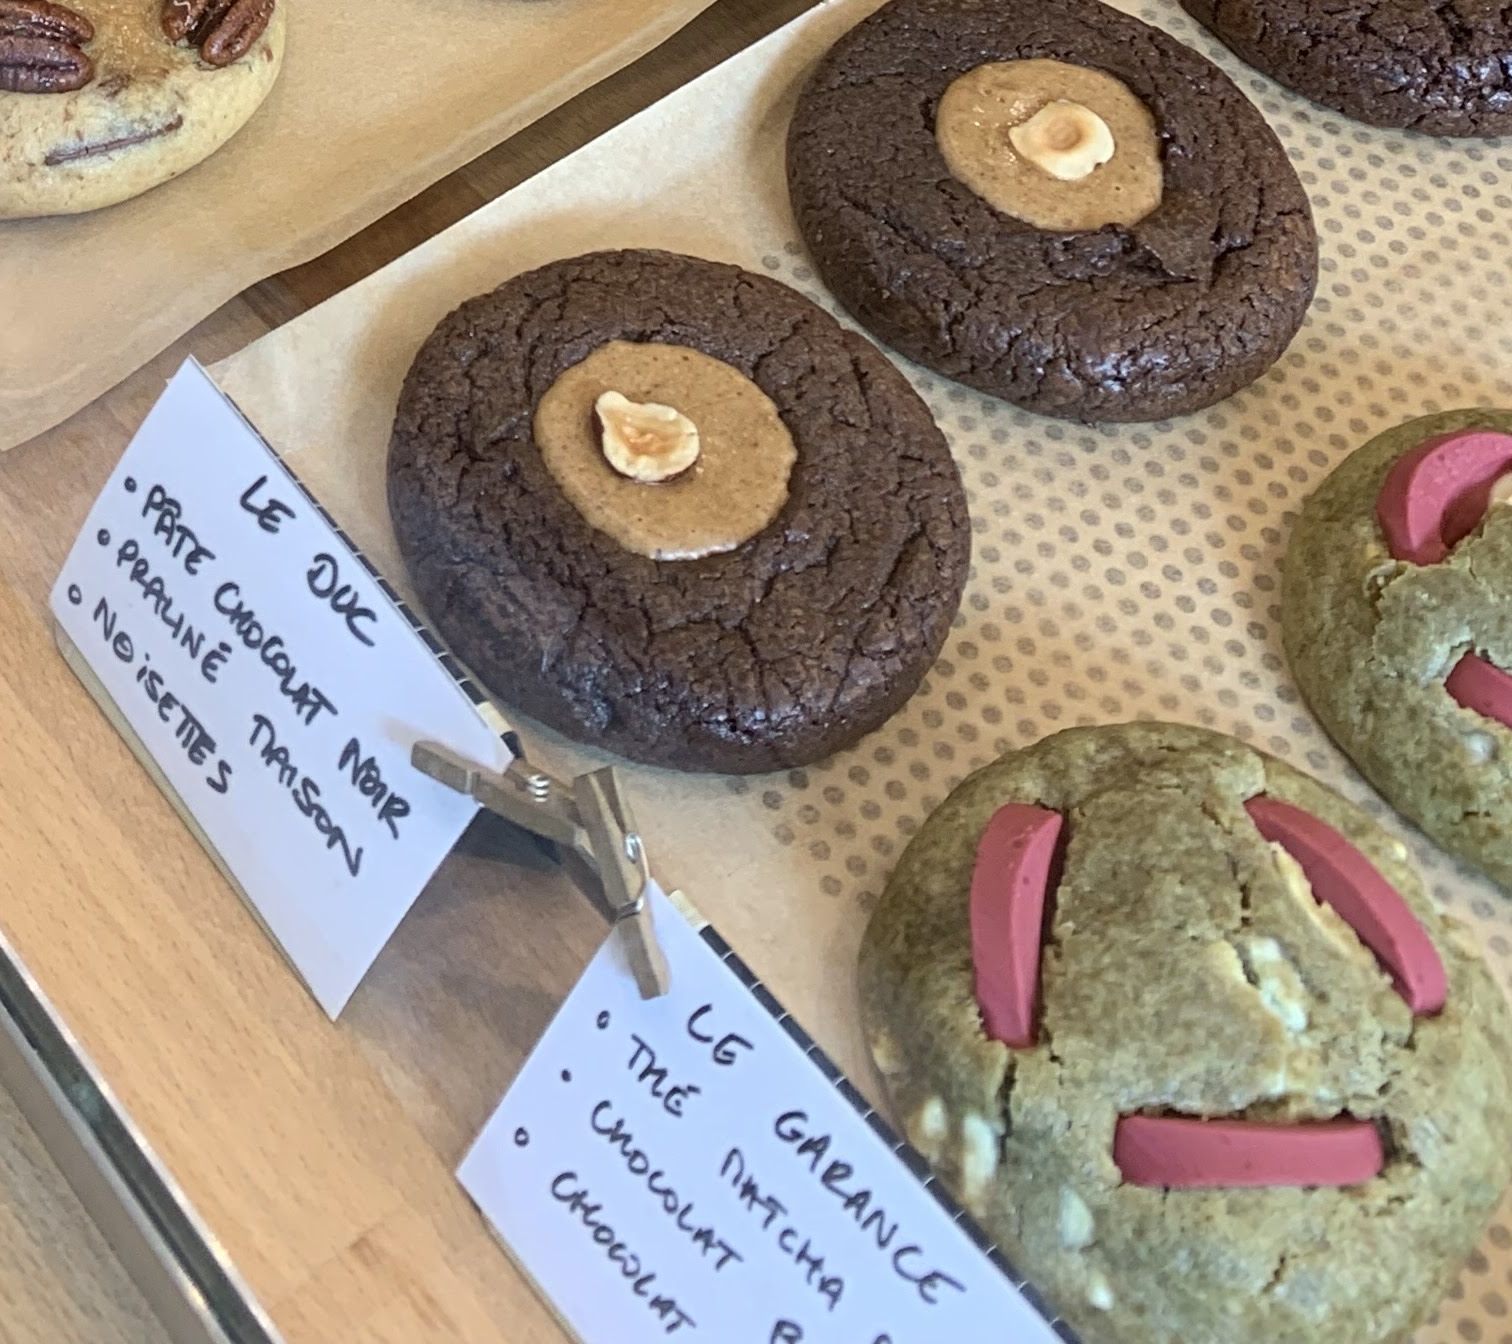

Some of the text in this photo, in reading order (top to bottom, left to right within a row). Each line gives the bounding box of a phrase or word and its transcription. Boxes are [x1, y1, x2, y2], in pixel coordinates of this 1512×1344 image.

[141, 483, 412, 840] PÂTE CHOCOLAT NOIR
[239, 475, 379, 648] LE DUC
[92, 596, 234, 795] NOISETTES
[115, 537, 364, 879] PRALINÉ MAISON
[551, 1171, 697, 1334] CHOCOLAT
[589, 1100, 746, 1272] CHOCOLAT
[626, 1032, 847, 1312] THÉ MATCHA
[687, 1003, 967, 1306] LE GARANCE
